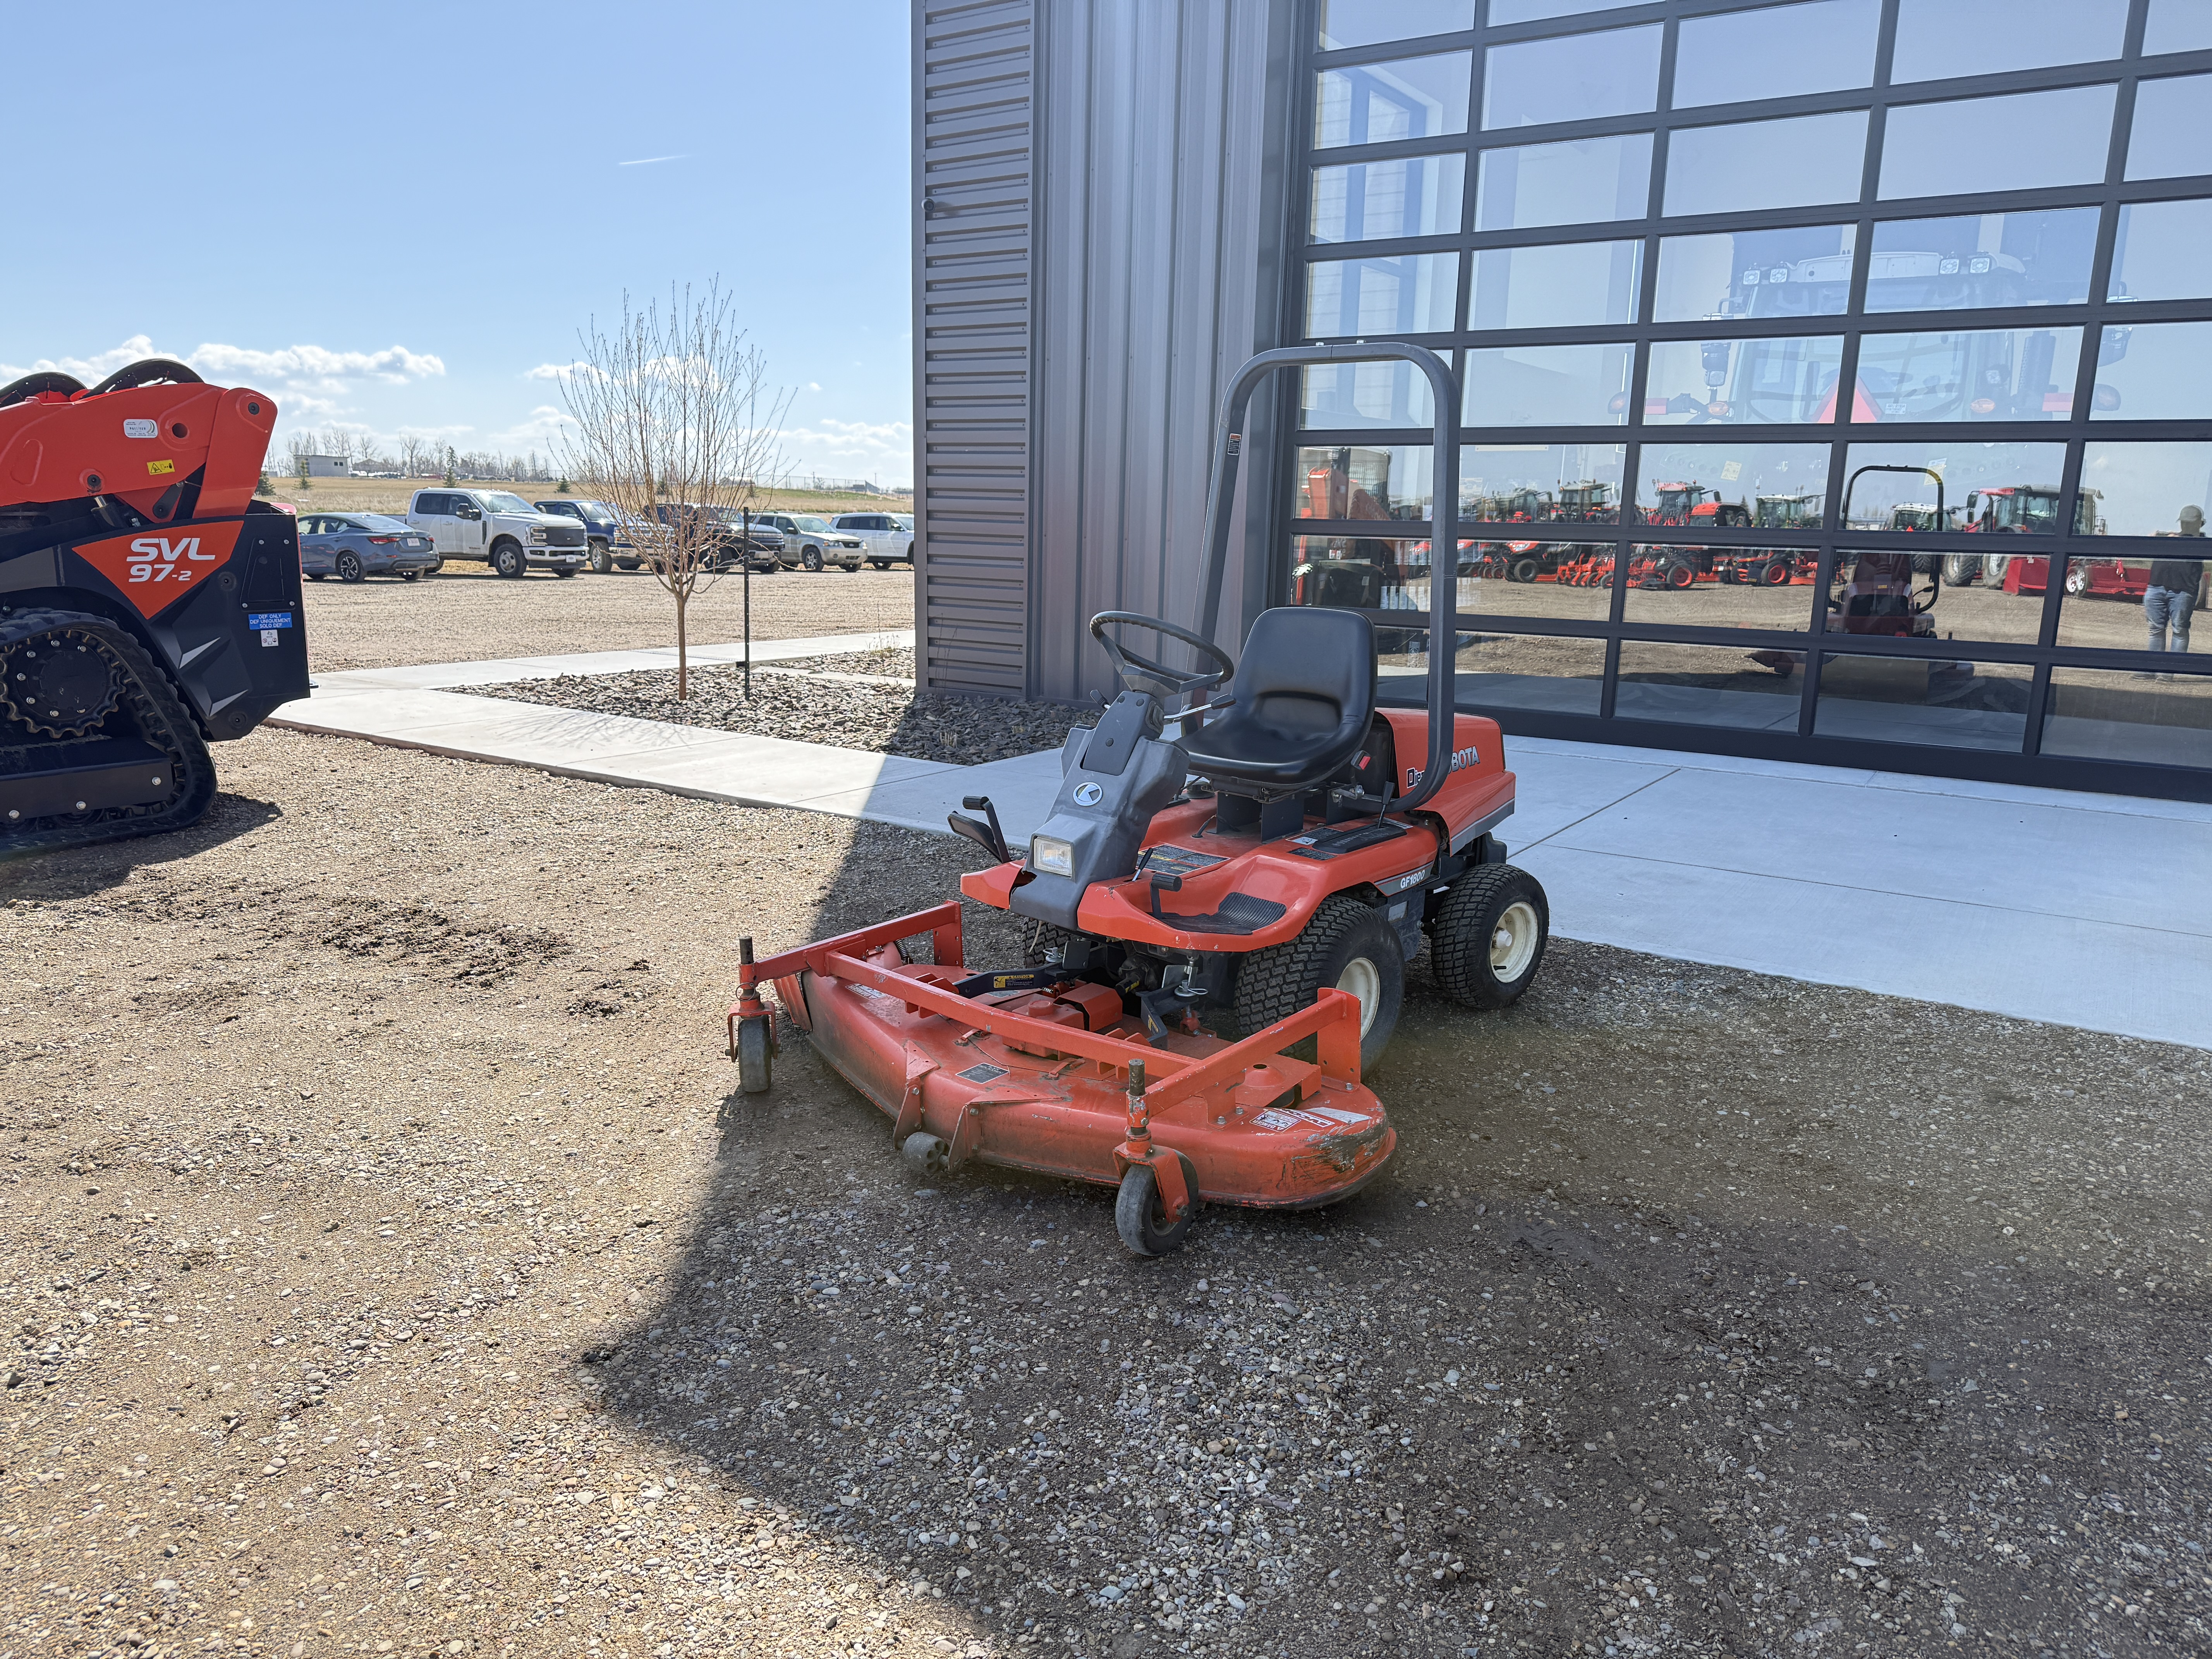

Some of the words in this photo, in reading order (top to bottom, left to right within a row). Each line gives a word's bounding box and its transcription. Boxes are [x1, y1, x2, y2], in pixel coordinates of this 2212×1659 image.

[126, 538, 216, 562] SVL
[128, 564, 192, 582] 97-2
[1448, 745, 1480, 774] BOTA
[1400, 869, 1425, 889] GF1800
